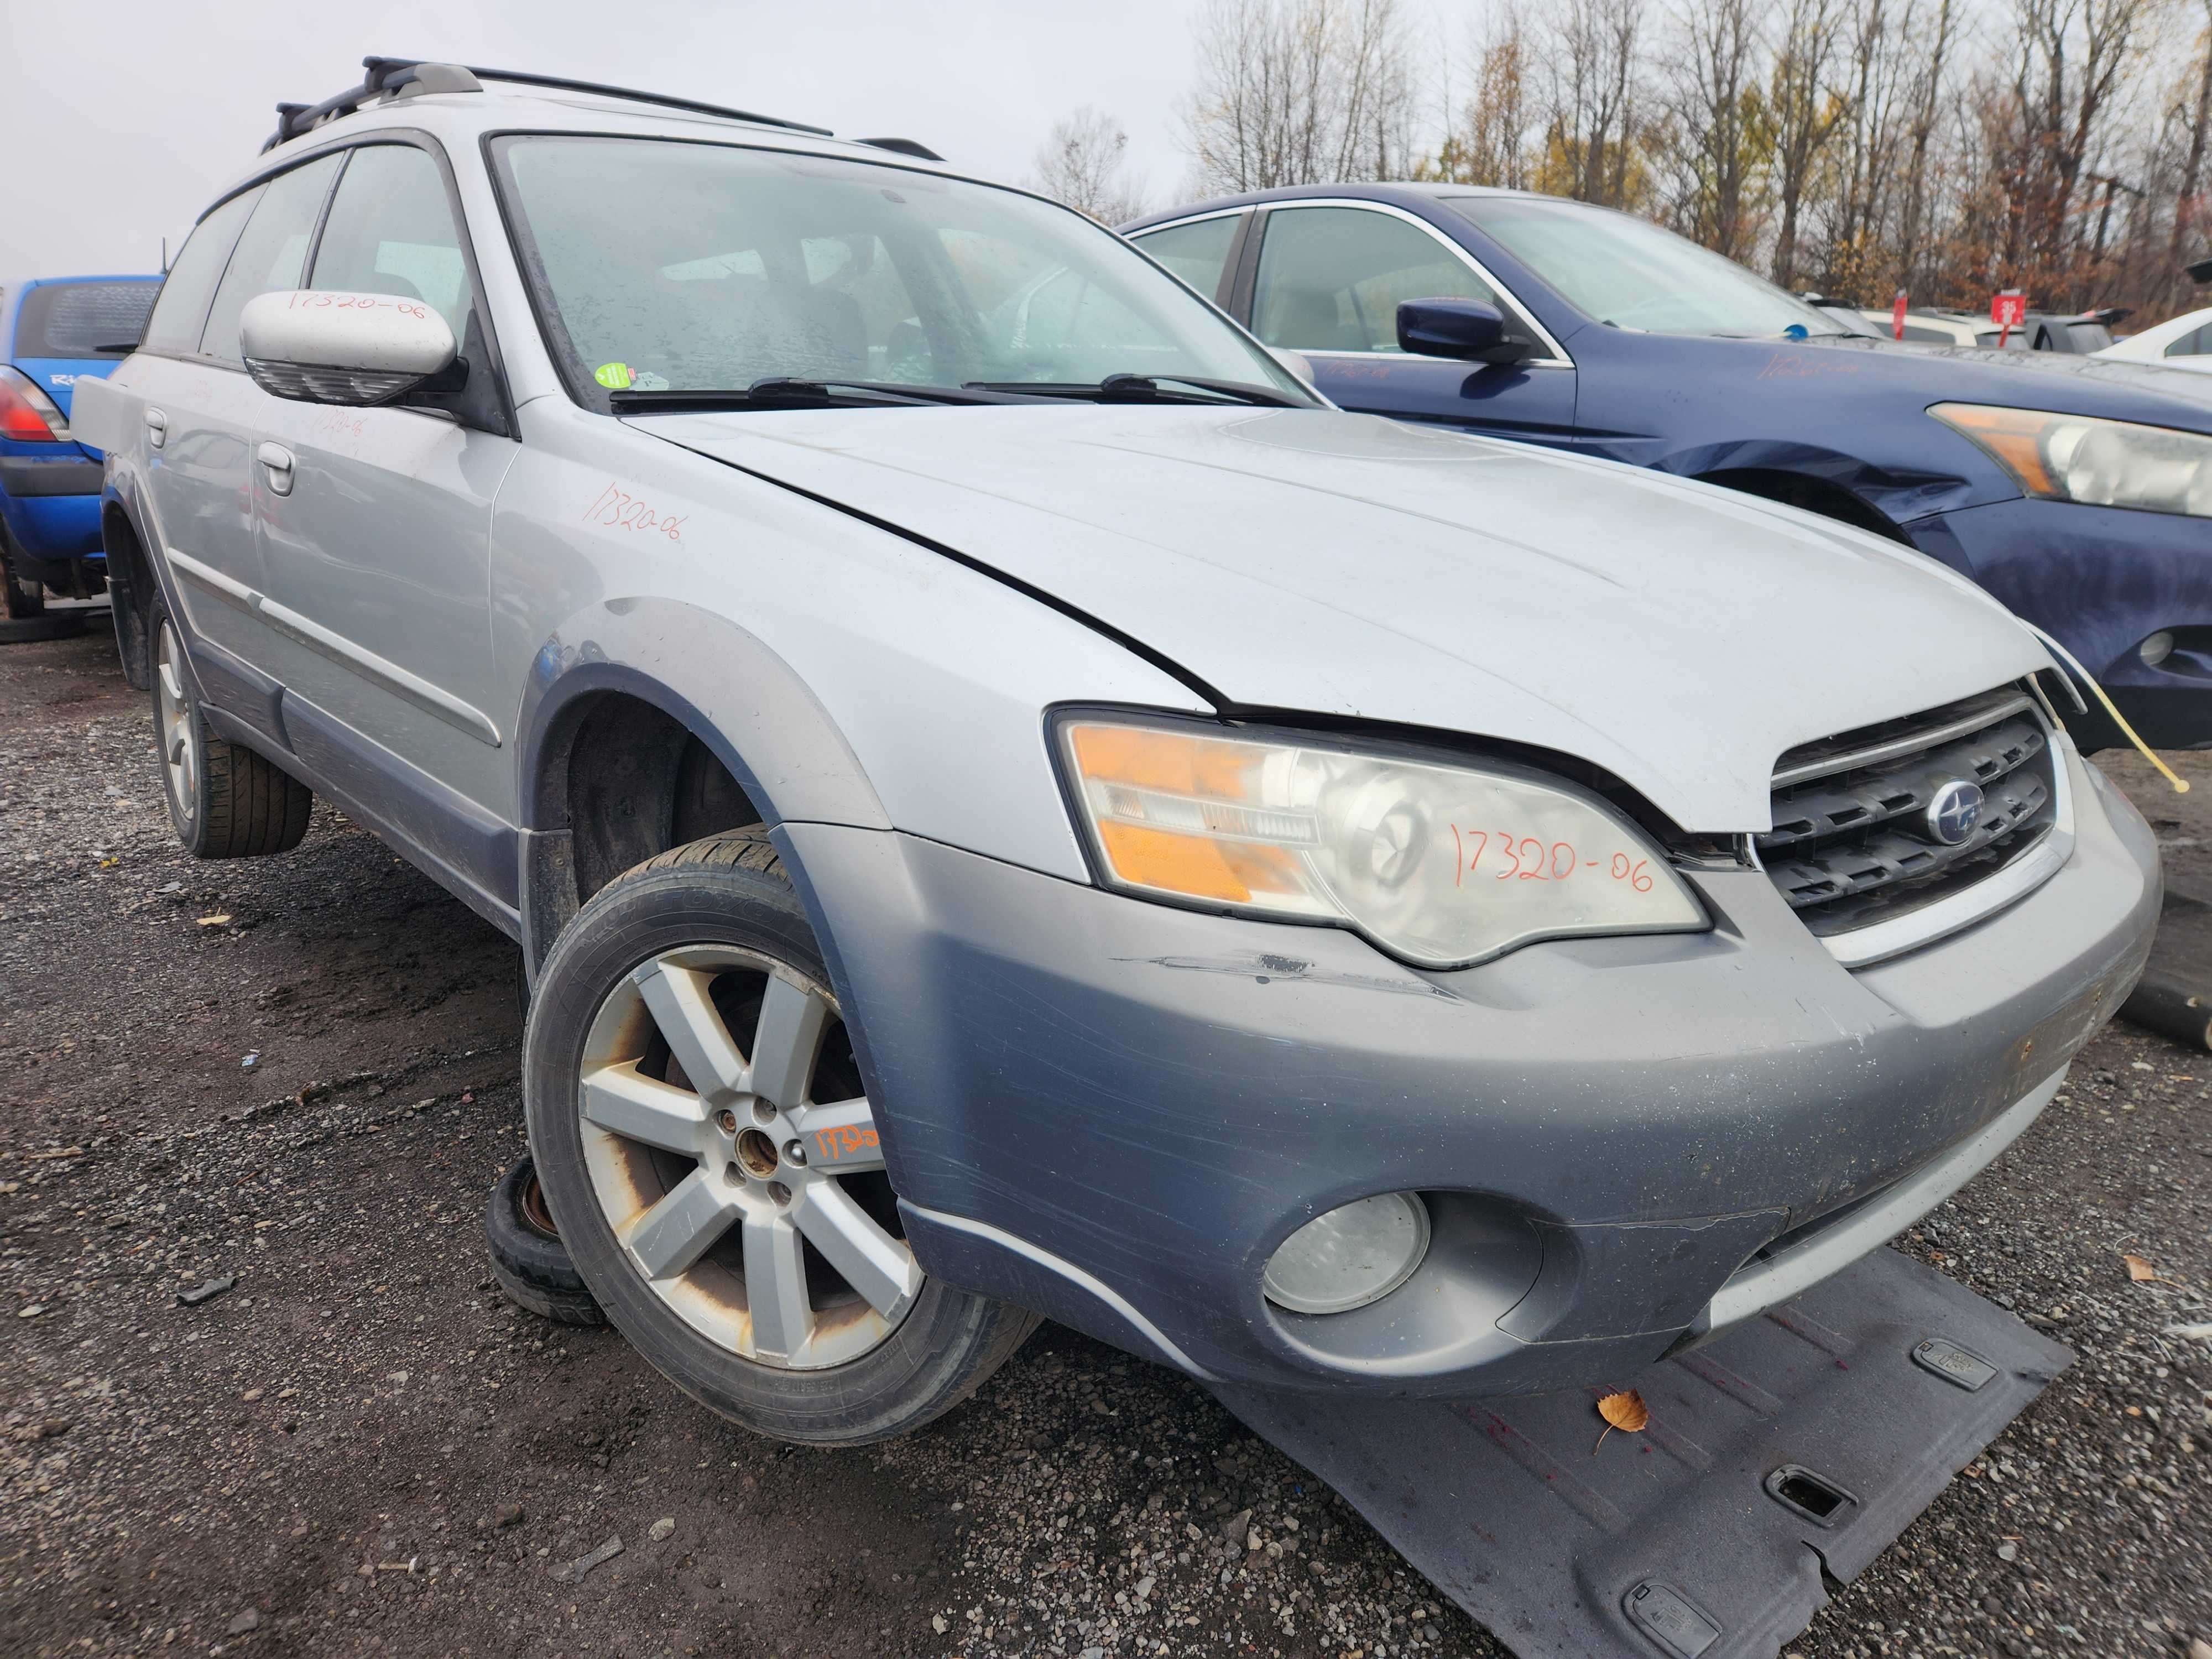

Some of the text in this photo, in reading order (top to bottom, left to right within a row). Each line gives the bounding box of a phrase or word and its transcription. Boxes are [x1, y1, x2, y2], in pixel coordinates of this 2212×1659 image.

[288, 292, 426, 319] 17320-06
[49, 374, 75, 387] Ri
[582, 482, 688, 539] 17320-06
[1451, 823, 1653, 893] 17320-06
[655, 889, 779, 922] TOYO
